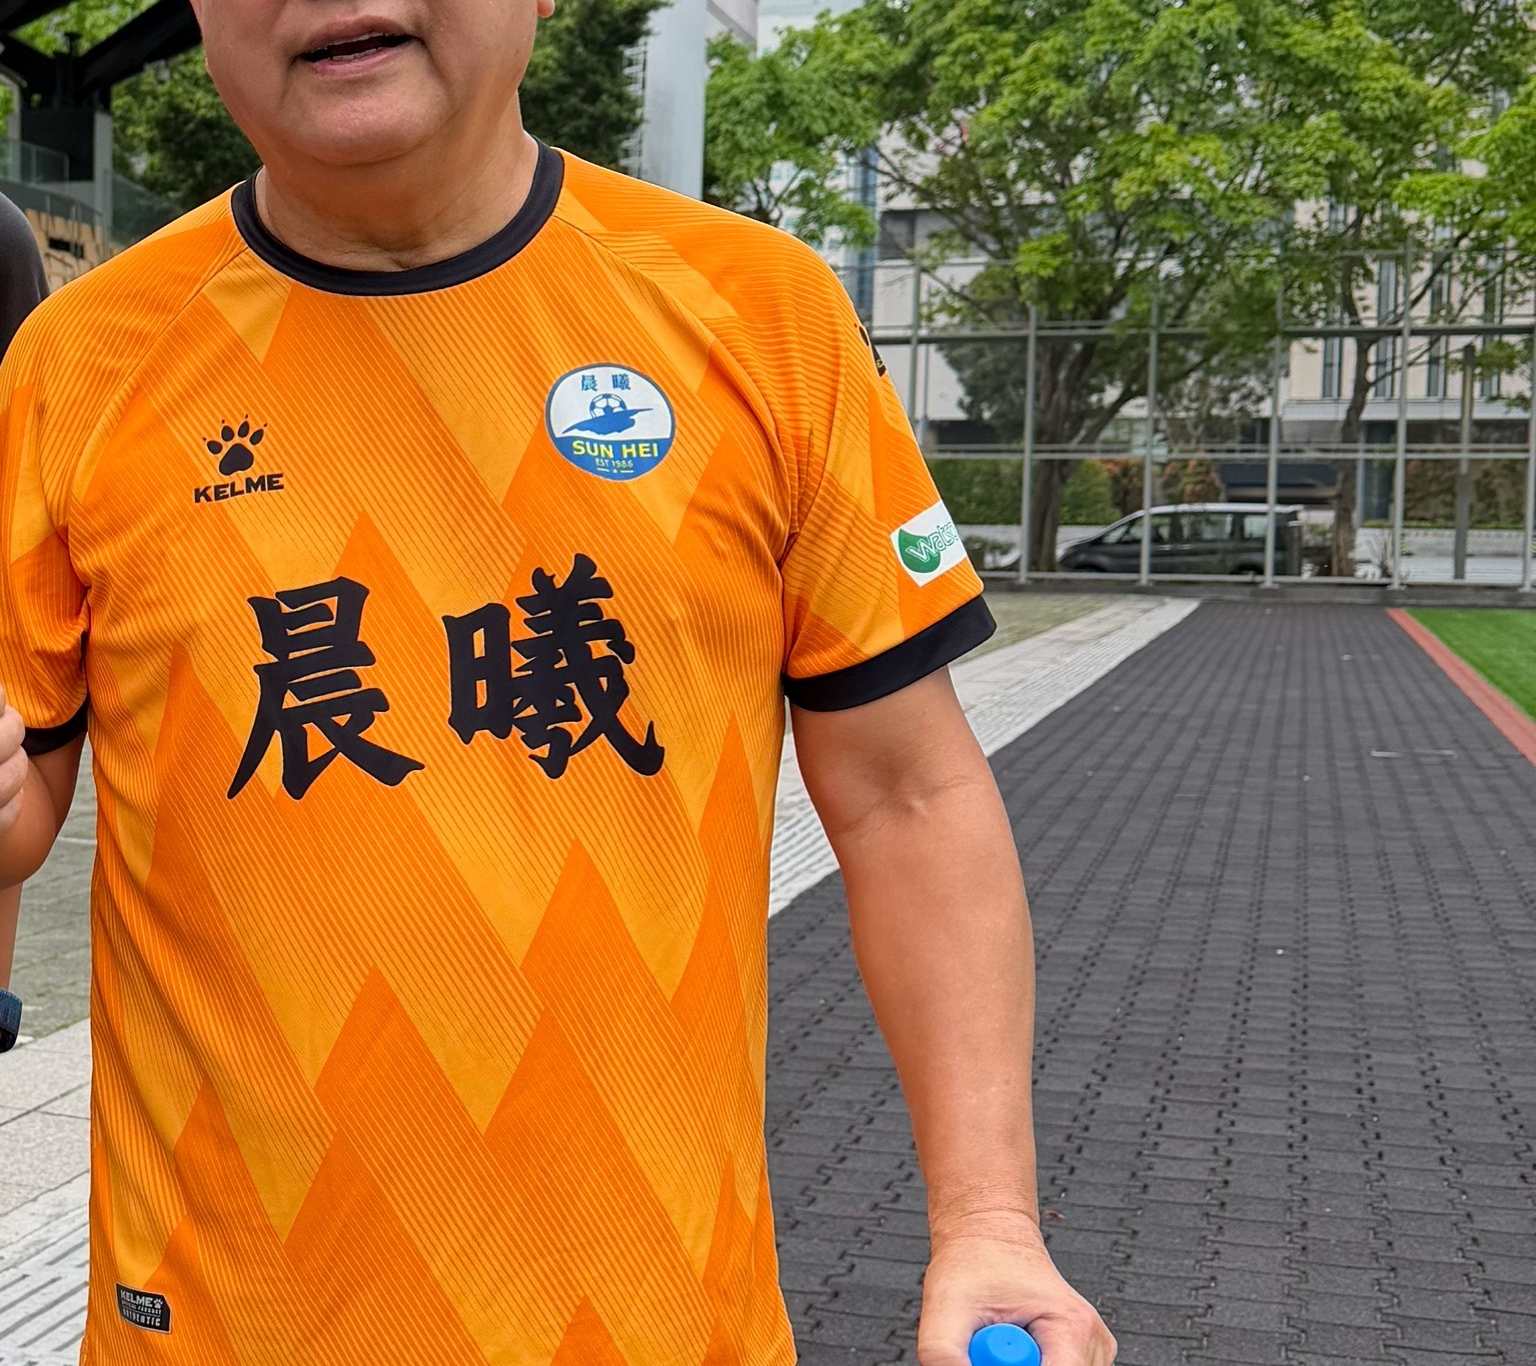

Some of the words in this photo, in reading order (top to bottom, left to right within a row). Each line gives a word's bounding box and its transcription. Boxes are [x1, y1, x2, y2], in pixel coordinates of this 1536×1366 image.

[572, 440, 613, 458] SUN
[622, 442, 658, 458] HEI
[194, 473, 285, 503] KELME
[227, 553, 665, 800] 晨曦
[120, 1290, 154, 1308] KELME
